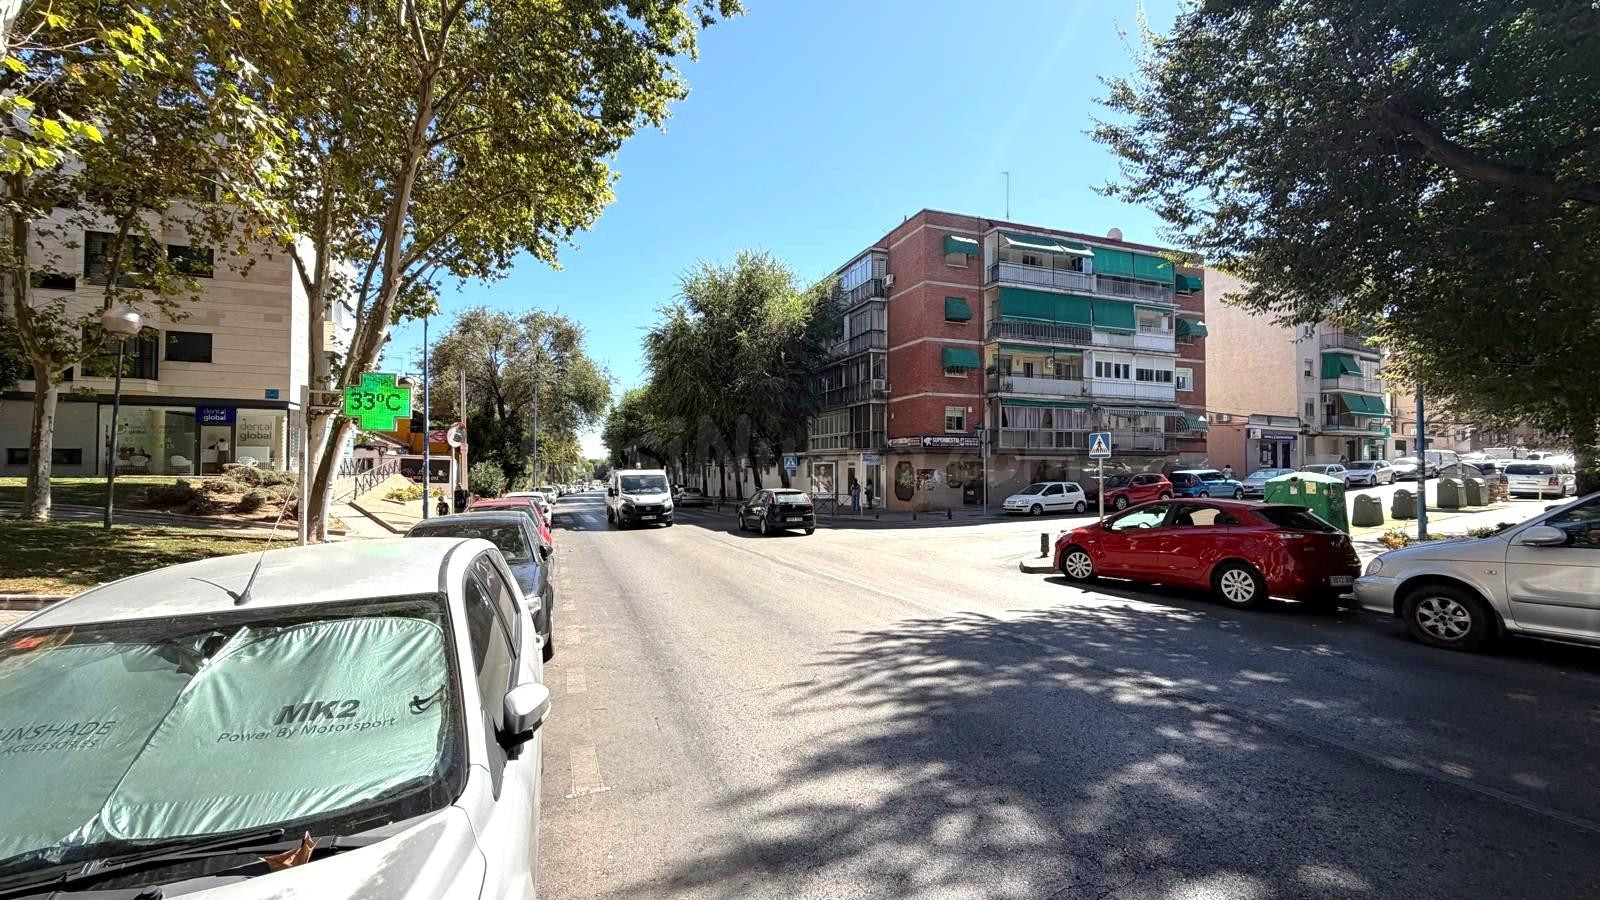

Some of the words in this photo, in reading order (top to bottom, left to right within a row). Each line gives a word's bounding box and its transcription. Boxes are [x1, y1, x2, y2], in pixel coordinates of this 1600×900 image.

[240, 421, 272, 431] dental
[240, 431, 272, 441] global
[273, 699, 361, 726] MK2
[0, 720, 117, 742] UNSHADE
[216, 732, 271, 743] Power
[276, 727, 298, 739] By
[300, 717, 396, 735] Motorsport
